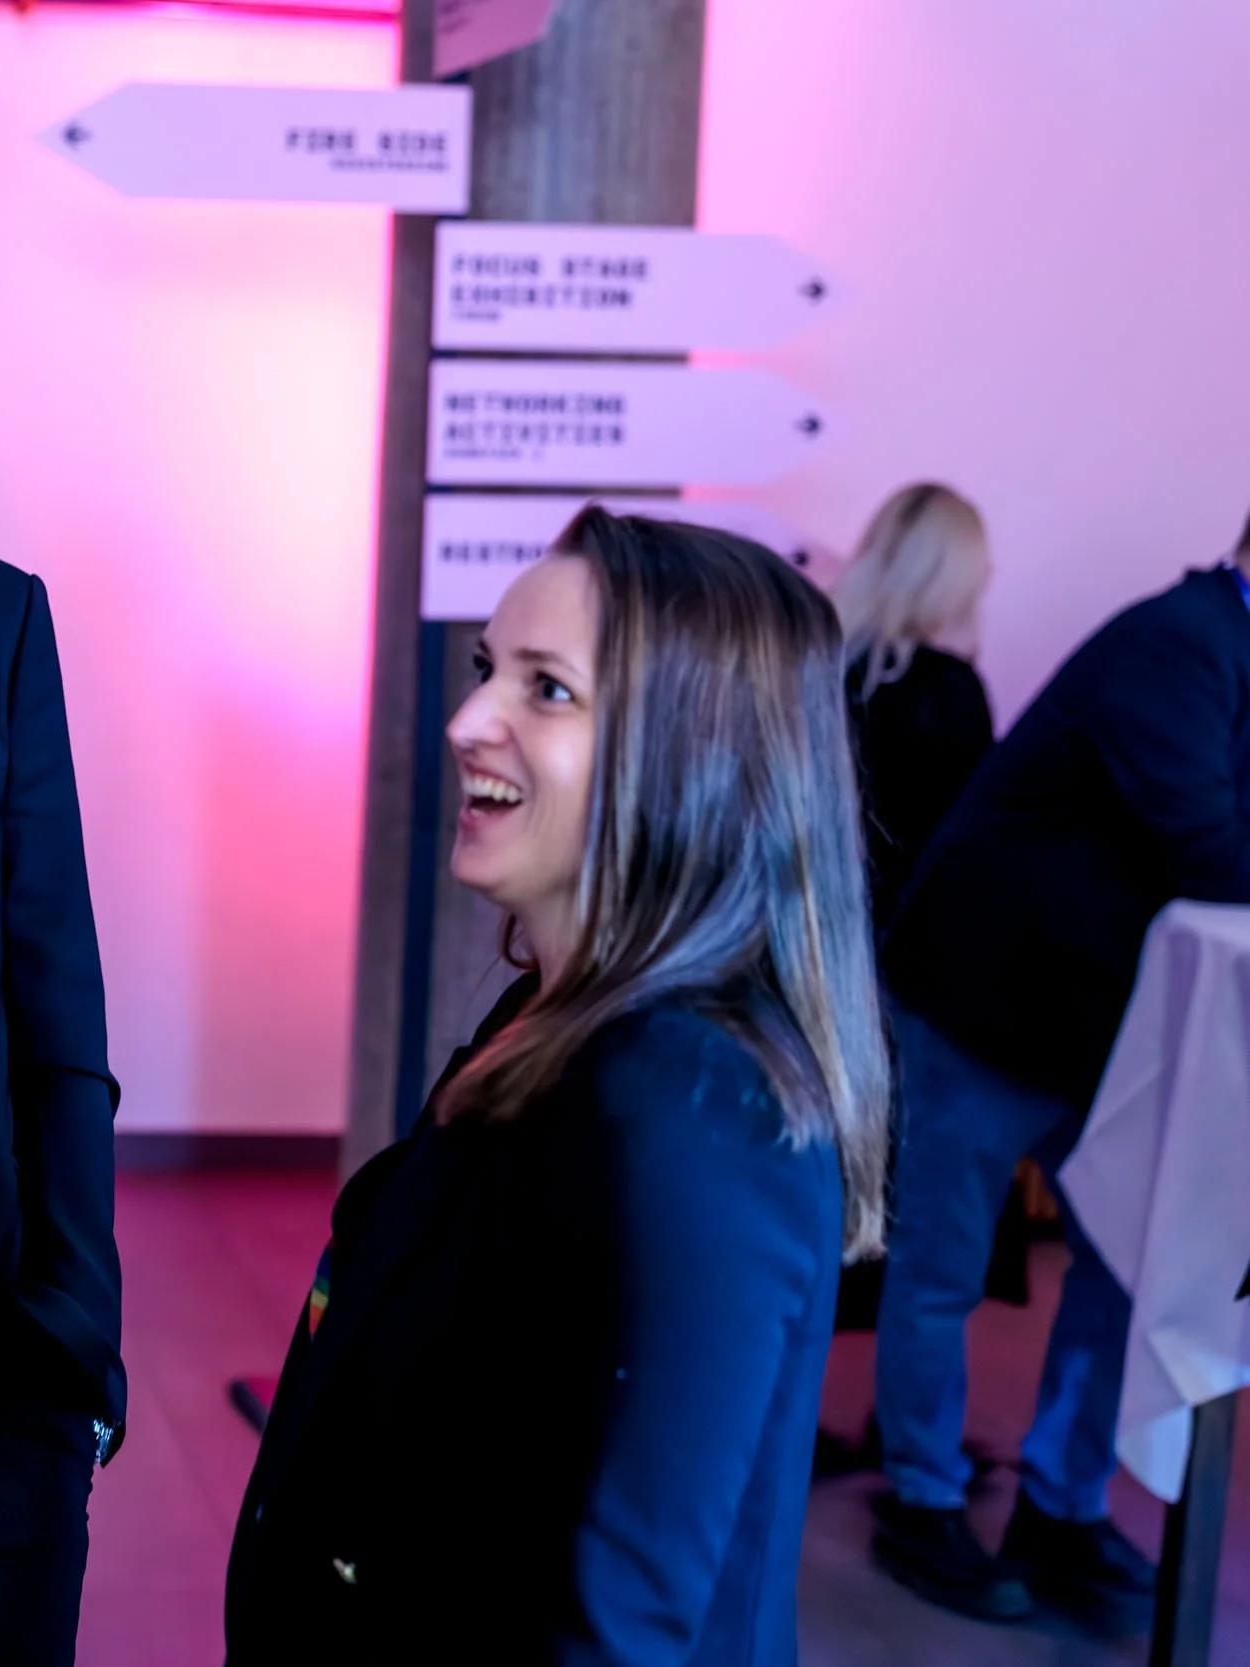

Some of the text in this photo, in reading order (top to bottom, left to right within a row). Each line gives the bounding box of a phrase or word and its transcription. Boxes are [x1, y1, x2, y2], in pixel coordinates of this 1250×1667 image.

[284, 128, 447, 155] FIRE SIDE
[451, 255, 649, 281] FOCUS STAGE
[451, 284, 633, 308] EXHIBITION
[445, 393, 626, 416] NETWORKING
[447, 422, 626, 446] ACTIVITIES
[439, 541, 547, 564] RESTRO
